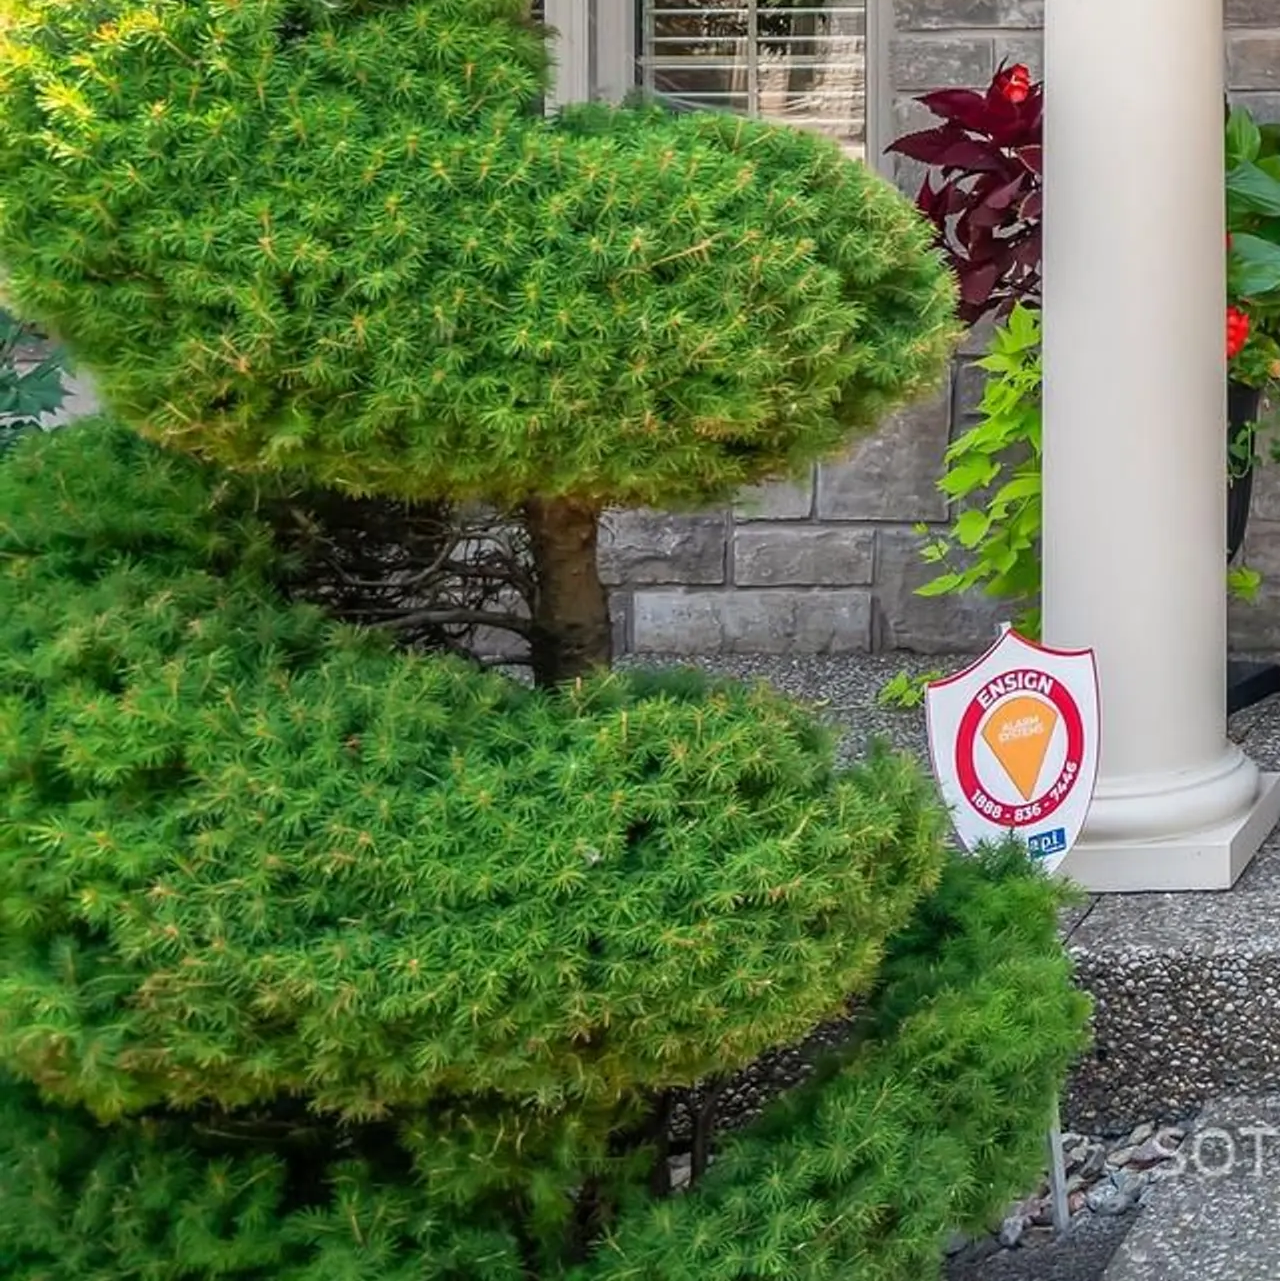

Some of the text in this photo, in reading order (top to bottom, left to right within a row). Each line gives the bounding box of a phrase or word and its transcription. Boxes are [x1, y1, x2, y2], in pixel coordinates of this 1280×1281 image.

[976, 671, 1054, 709] ENSIGN
[971, 789, 1003, 818] 1888
[1014, 803, 1041, 822] 836
[1050, 762, 1077, 803] 7446
